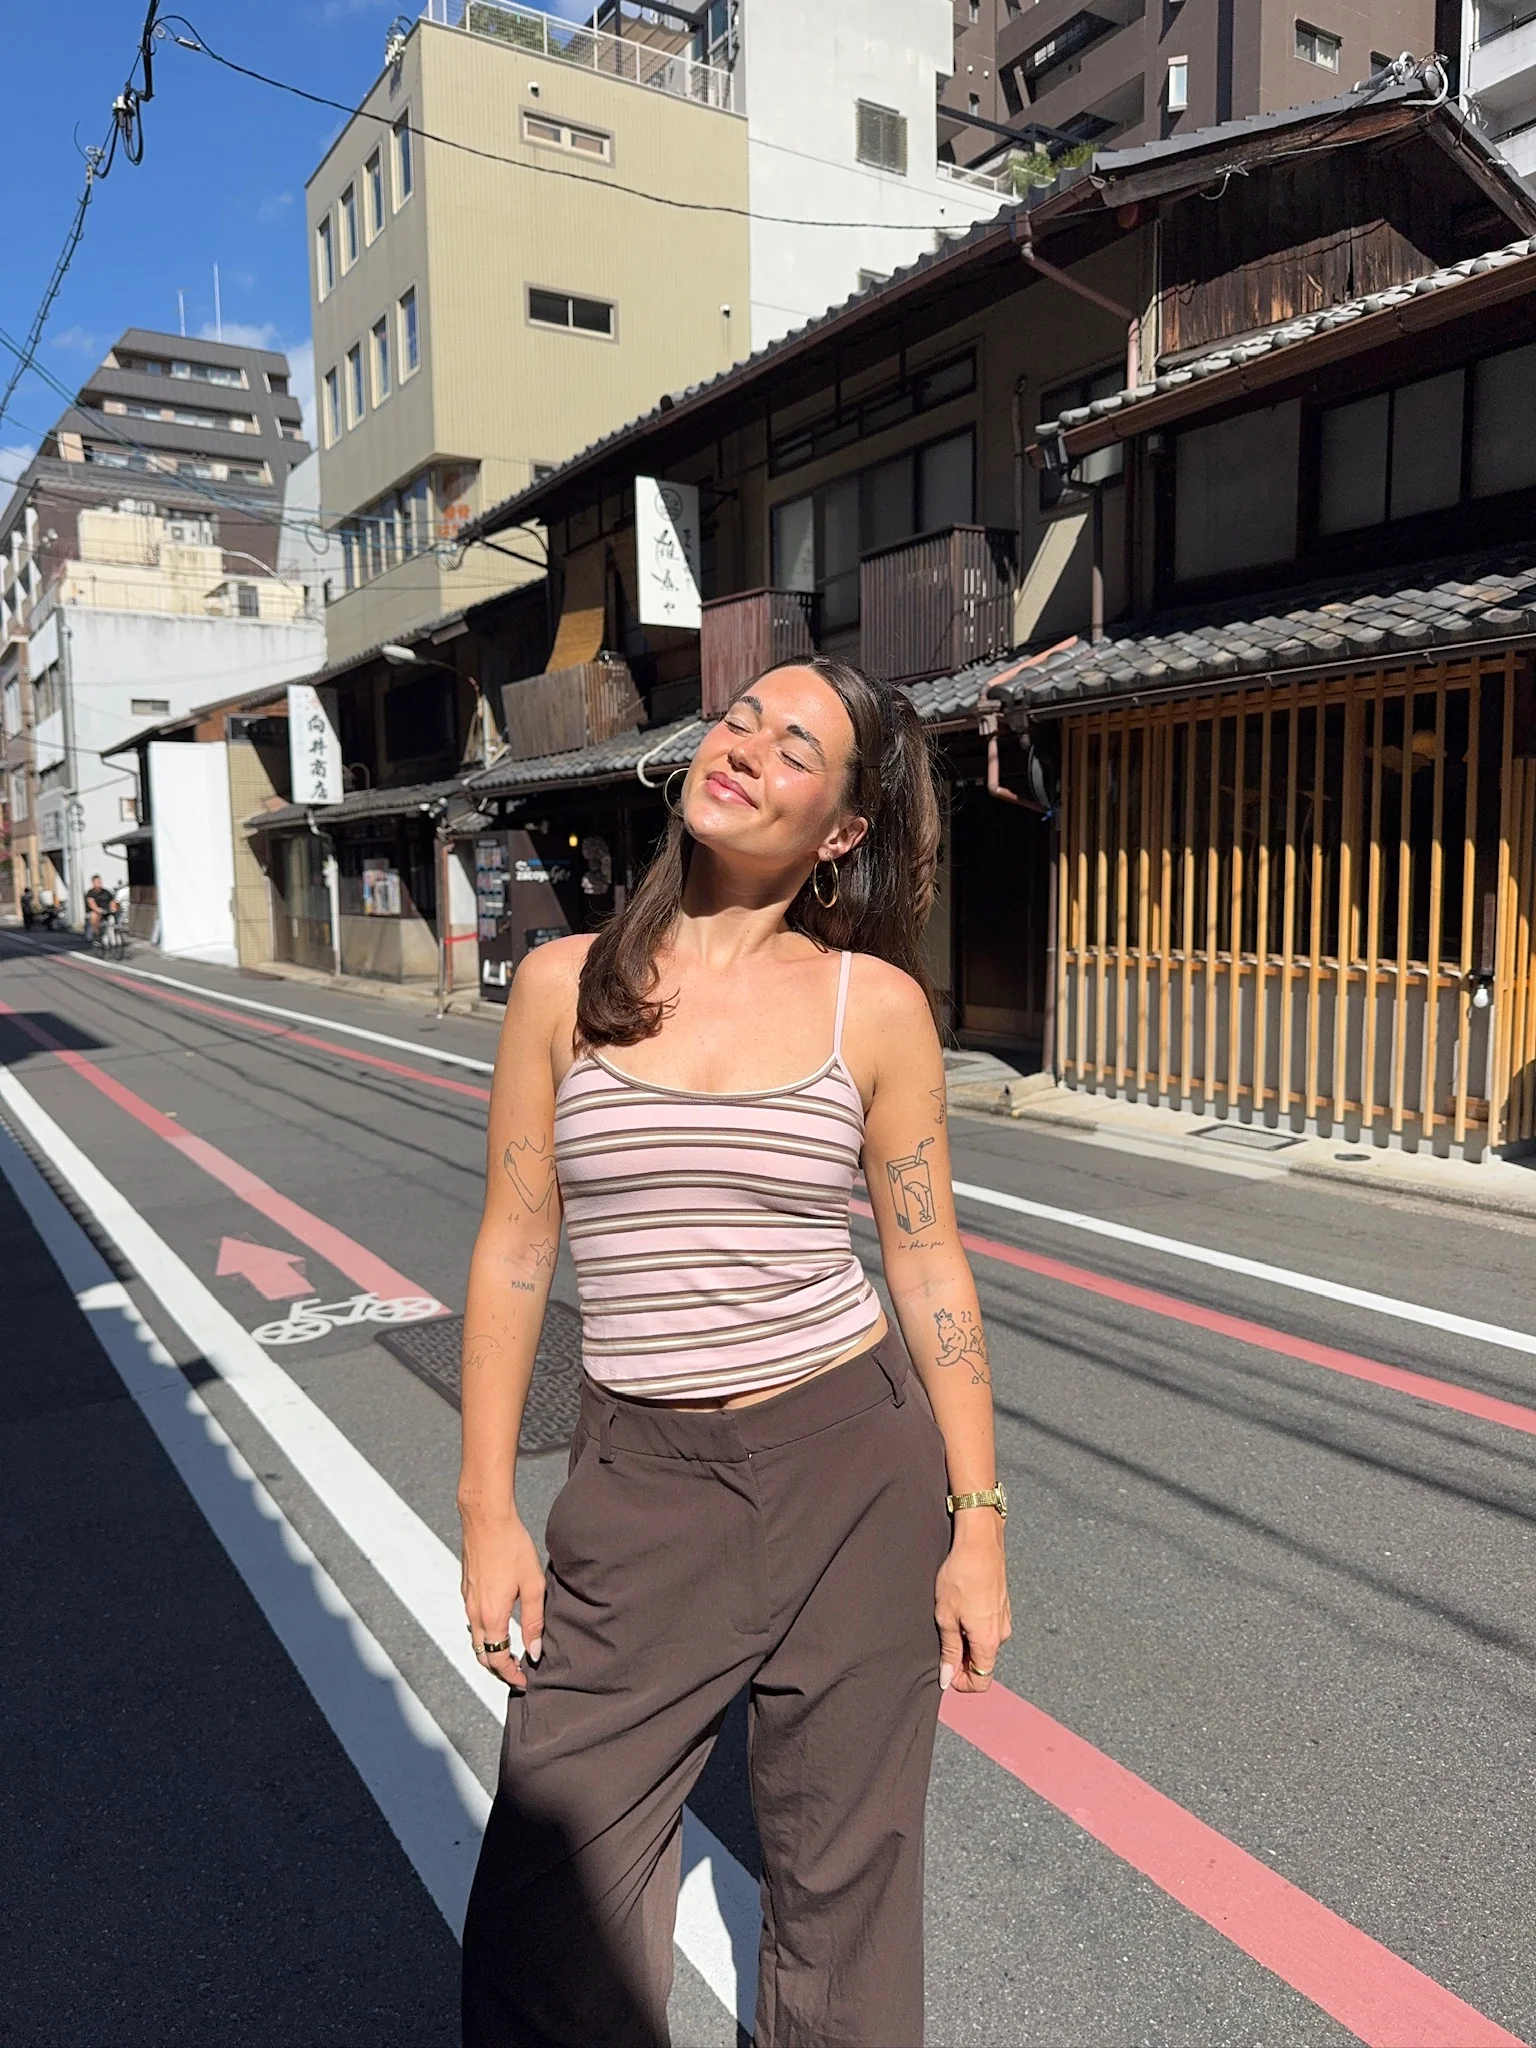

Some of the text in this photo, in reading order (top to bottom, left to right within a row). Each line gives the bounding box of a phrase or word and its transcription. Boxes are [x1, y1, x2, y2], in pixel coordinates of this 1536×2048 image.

[308, 714, 328, 800] 向井商店
[507, 1213, 520, 1225] 44
[511, 1280, 536, 1292] MAMAN
[961, 1311, 973, 1323] 22
